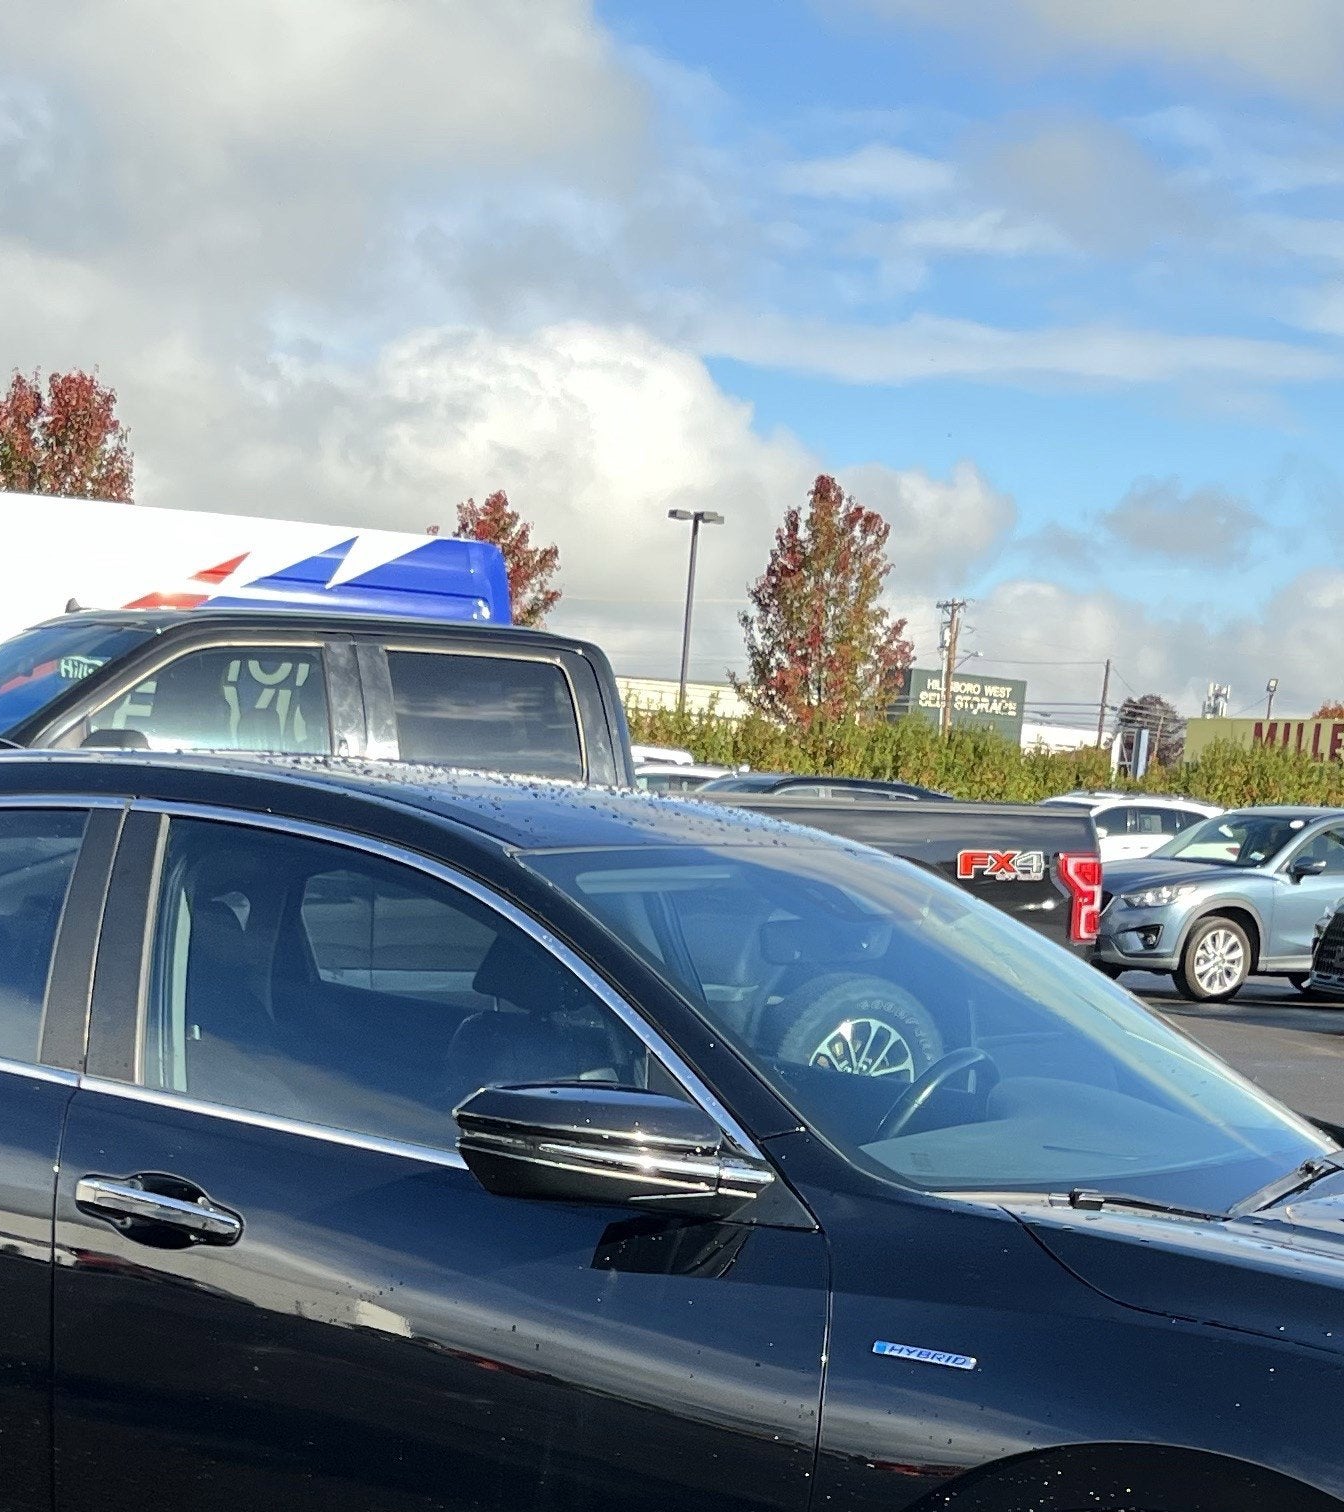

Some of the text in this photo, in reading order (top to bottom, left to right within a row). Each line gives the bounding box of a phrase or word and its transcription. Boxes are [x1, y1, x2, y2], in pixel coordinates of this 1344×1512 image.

[918, 691, 947, 708] SEL
[984, 685, 1012, 698] WEST
[957, 849, 1044, 879] FX4
[888, 1345, 967, 1366] HYBRID
